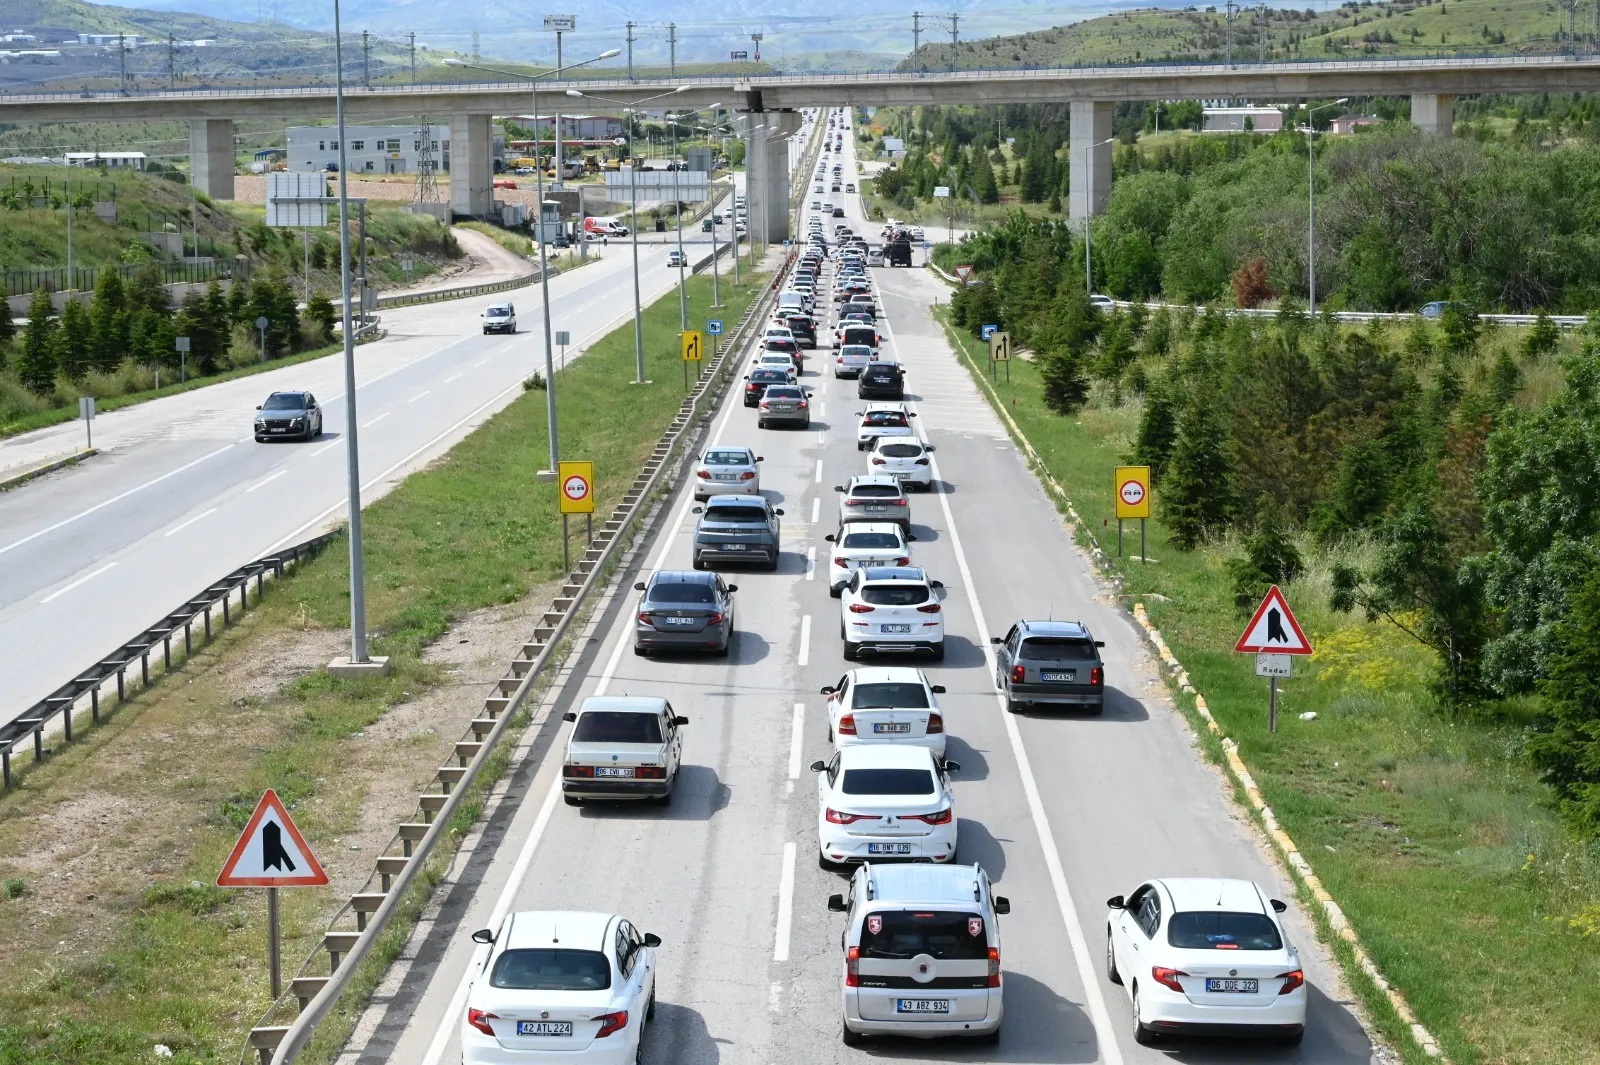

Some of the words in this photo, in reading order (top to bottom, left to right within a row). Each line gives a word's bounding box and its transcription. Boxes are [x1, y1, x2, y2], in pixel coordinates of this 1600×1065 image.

[1225, 981, 1238, 990] DDE
[1242, 982, 1256, 990] 323
[903, 999, 912, 1009] 43
[916, 999, 929, 1010] ABZ
[934, 1000, 947, 1010] 934
[523, 1024, 534, 1032] 42
[537, 1024, 552, 1032] ATL
[554, 1024, 570, 1032] 224
